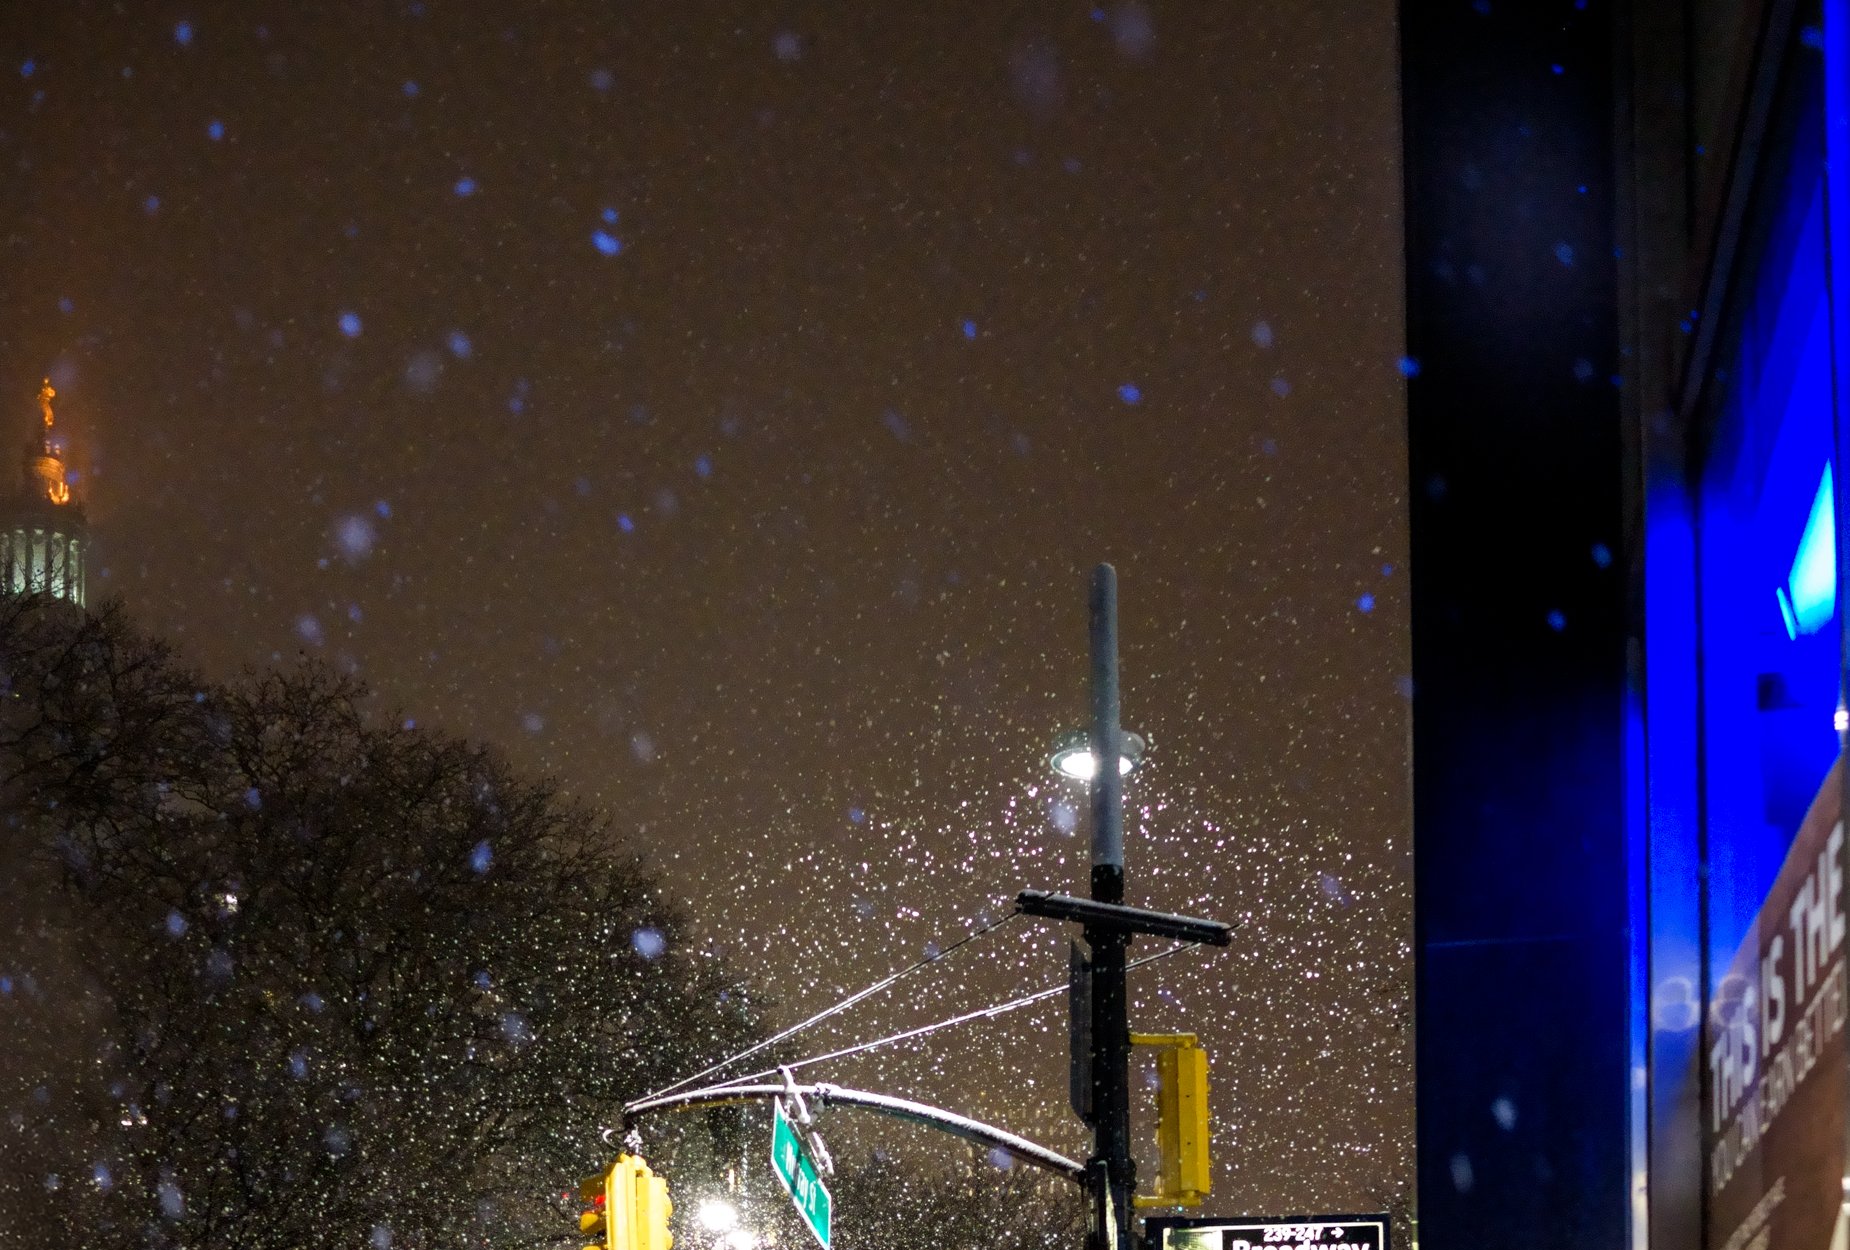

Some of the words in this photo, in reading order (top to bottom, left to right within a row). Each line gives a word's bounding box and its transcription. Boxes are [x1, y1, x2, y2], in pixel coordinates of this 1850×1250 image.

[1710, 986, 1757, 1133] THIS
[1762, 935, 1785, 1058] IS
[1790, 820, 1845, 1005] THE
[1263, 1227, 1324, 1242] 239-247
